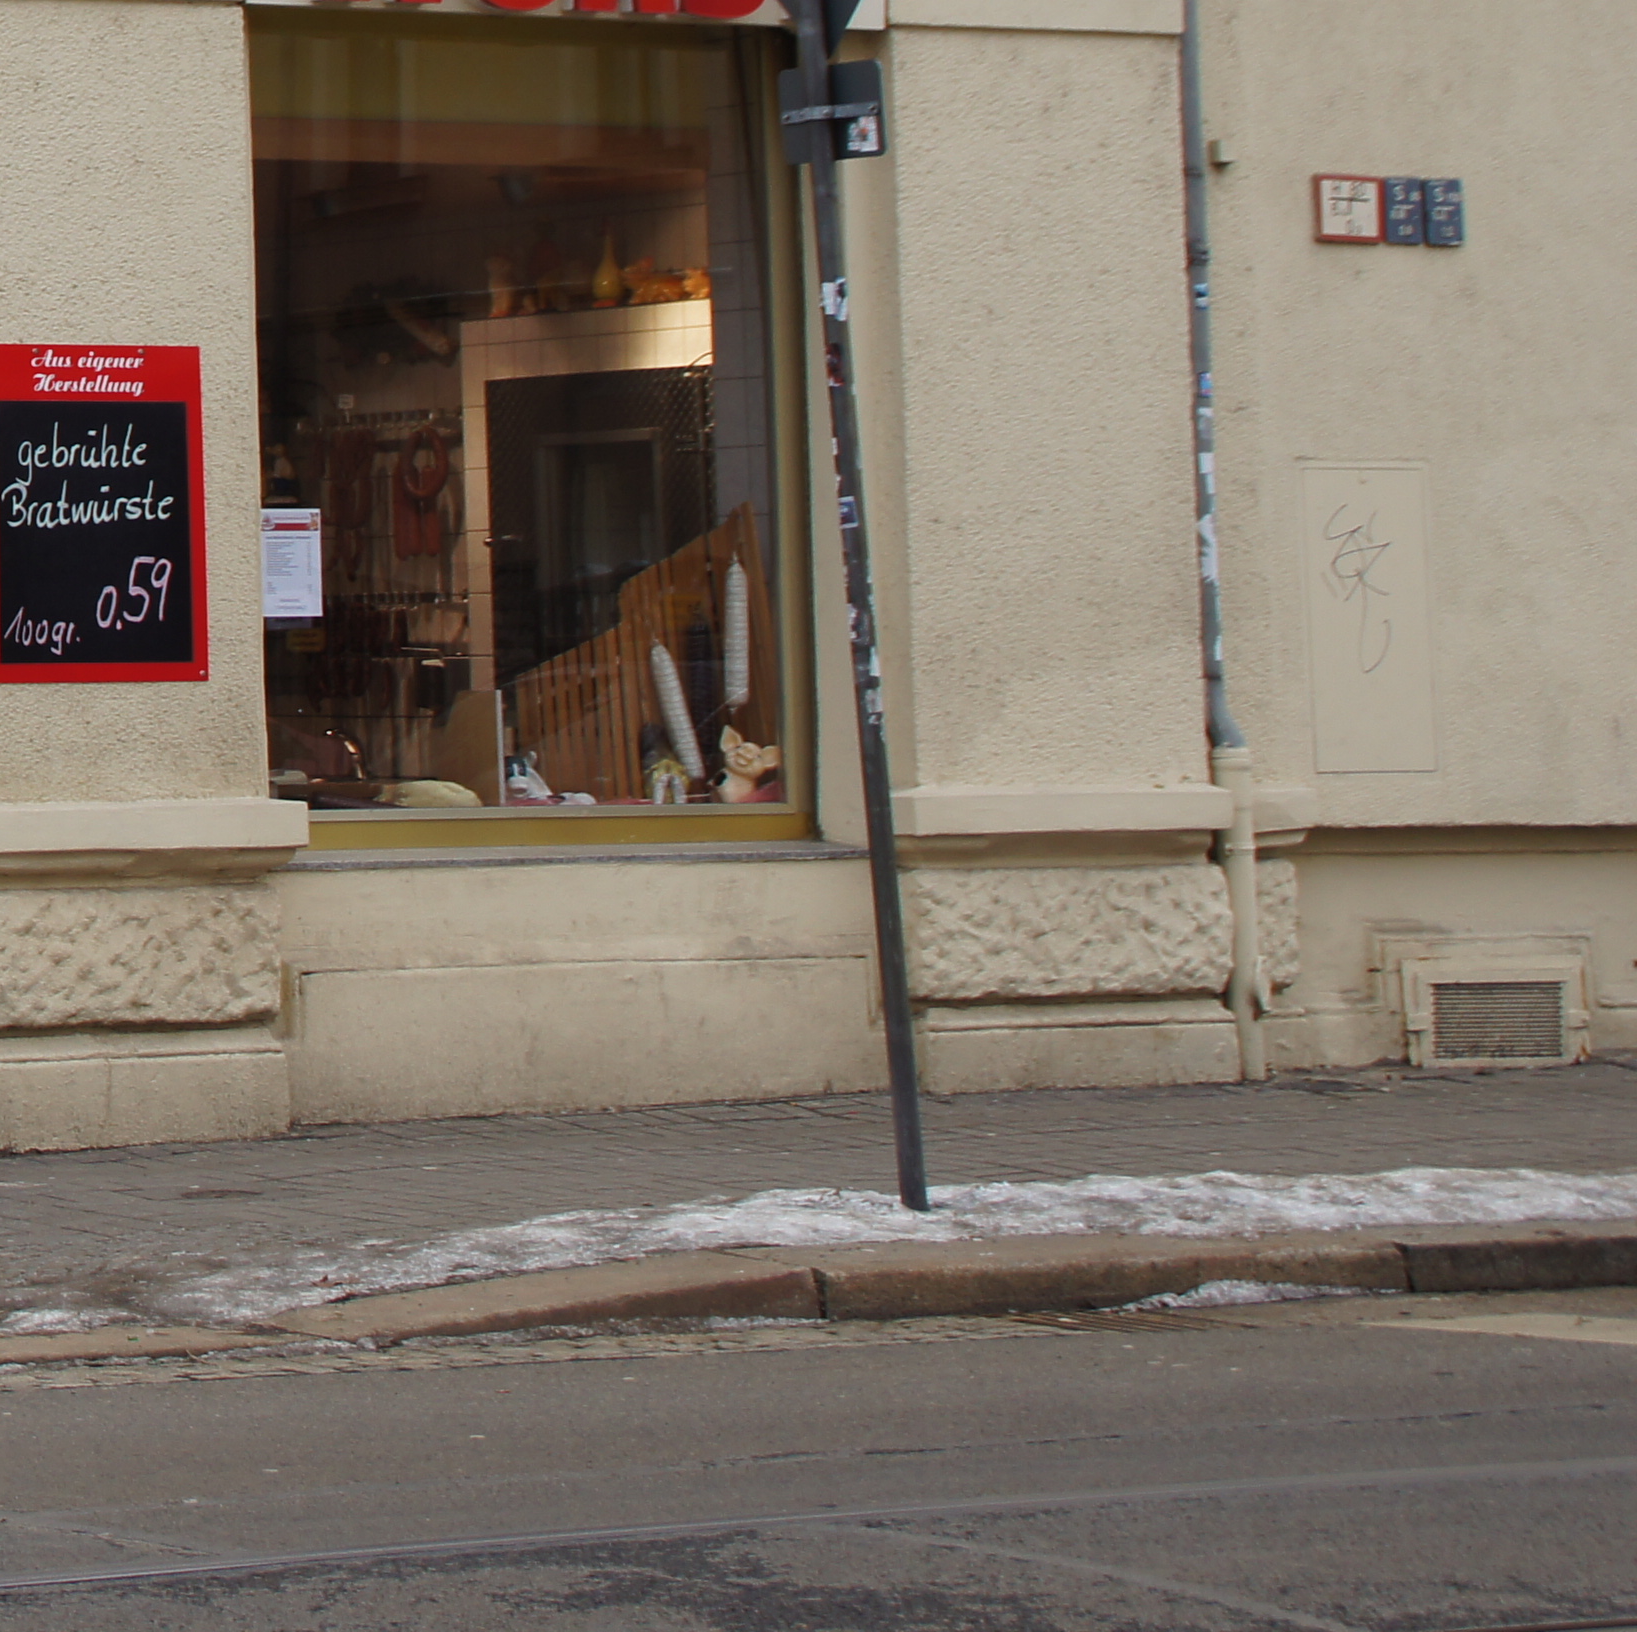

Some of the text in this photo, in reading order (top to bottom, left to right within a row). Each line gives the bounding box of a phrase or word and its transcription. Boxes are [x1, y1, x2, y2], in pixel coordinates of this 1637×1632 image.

[30, 349, 144, 371] Aus eigener
[32, 373, 145, 397] Herstellung
[16, 420, 148, 484] gebrühte
[0, 479, 176, 529] Bratwürste
